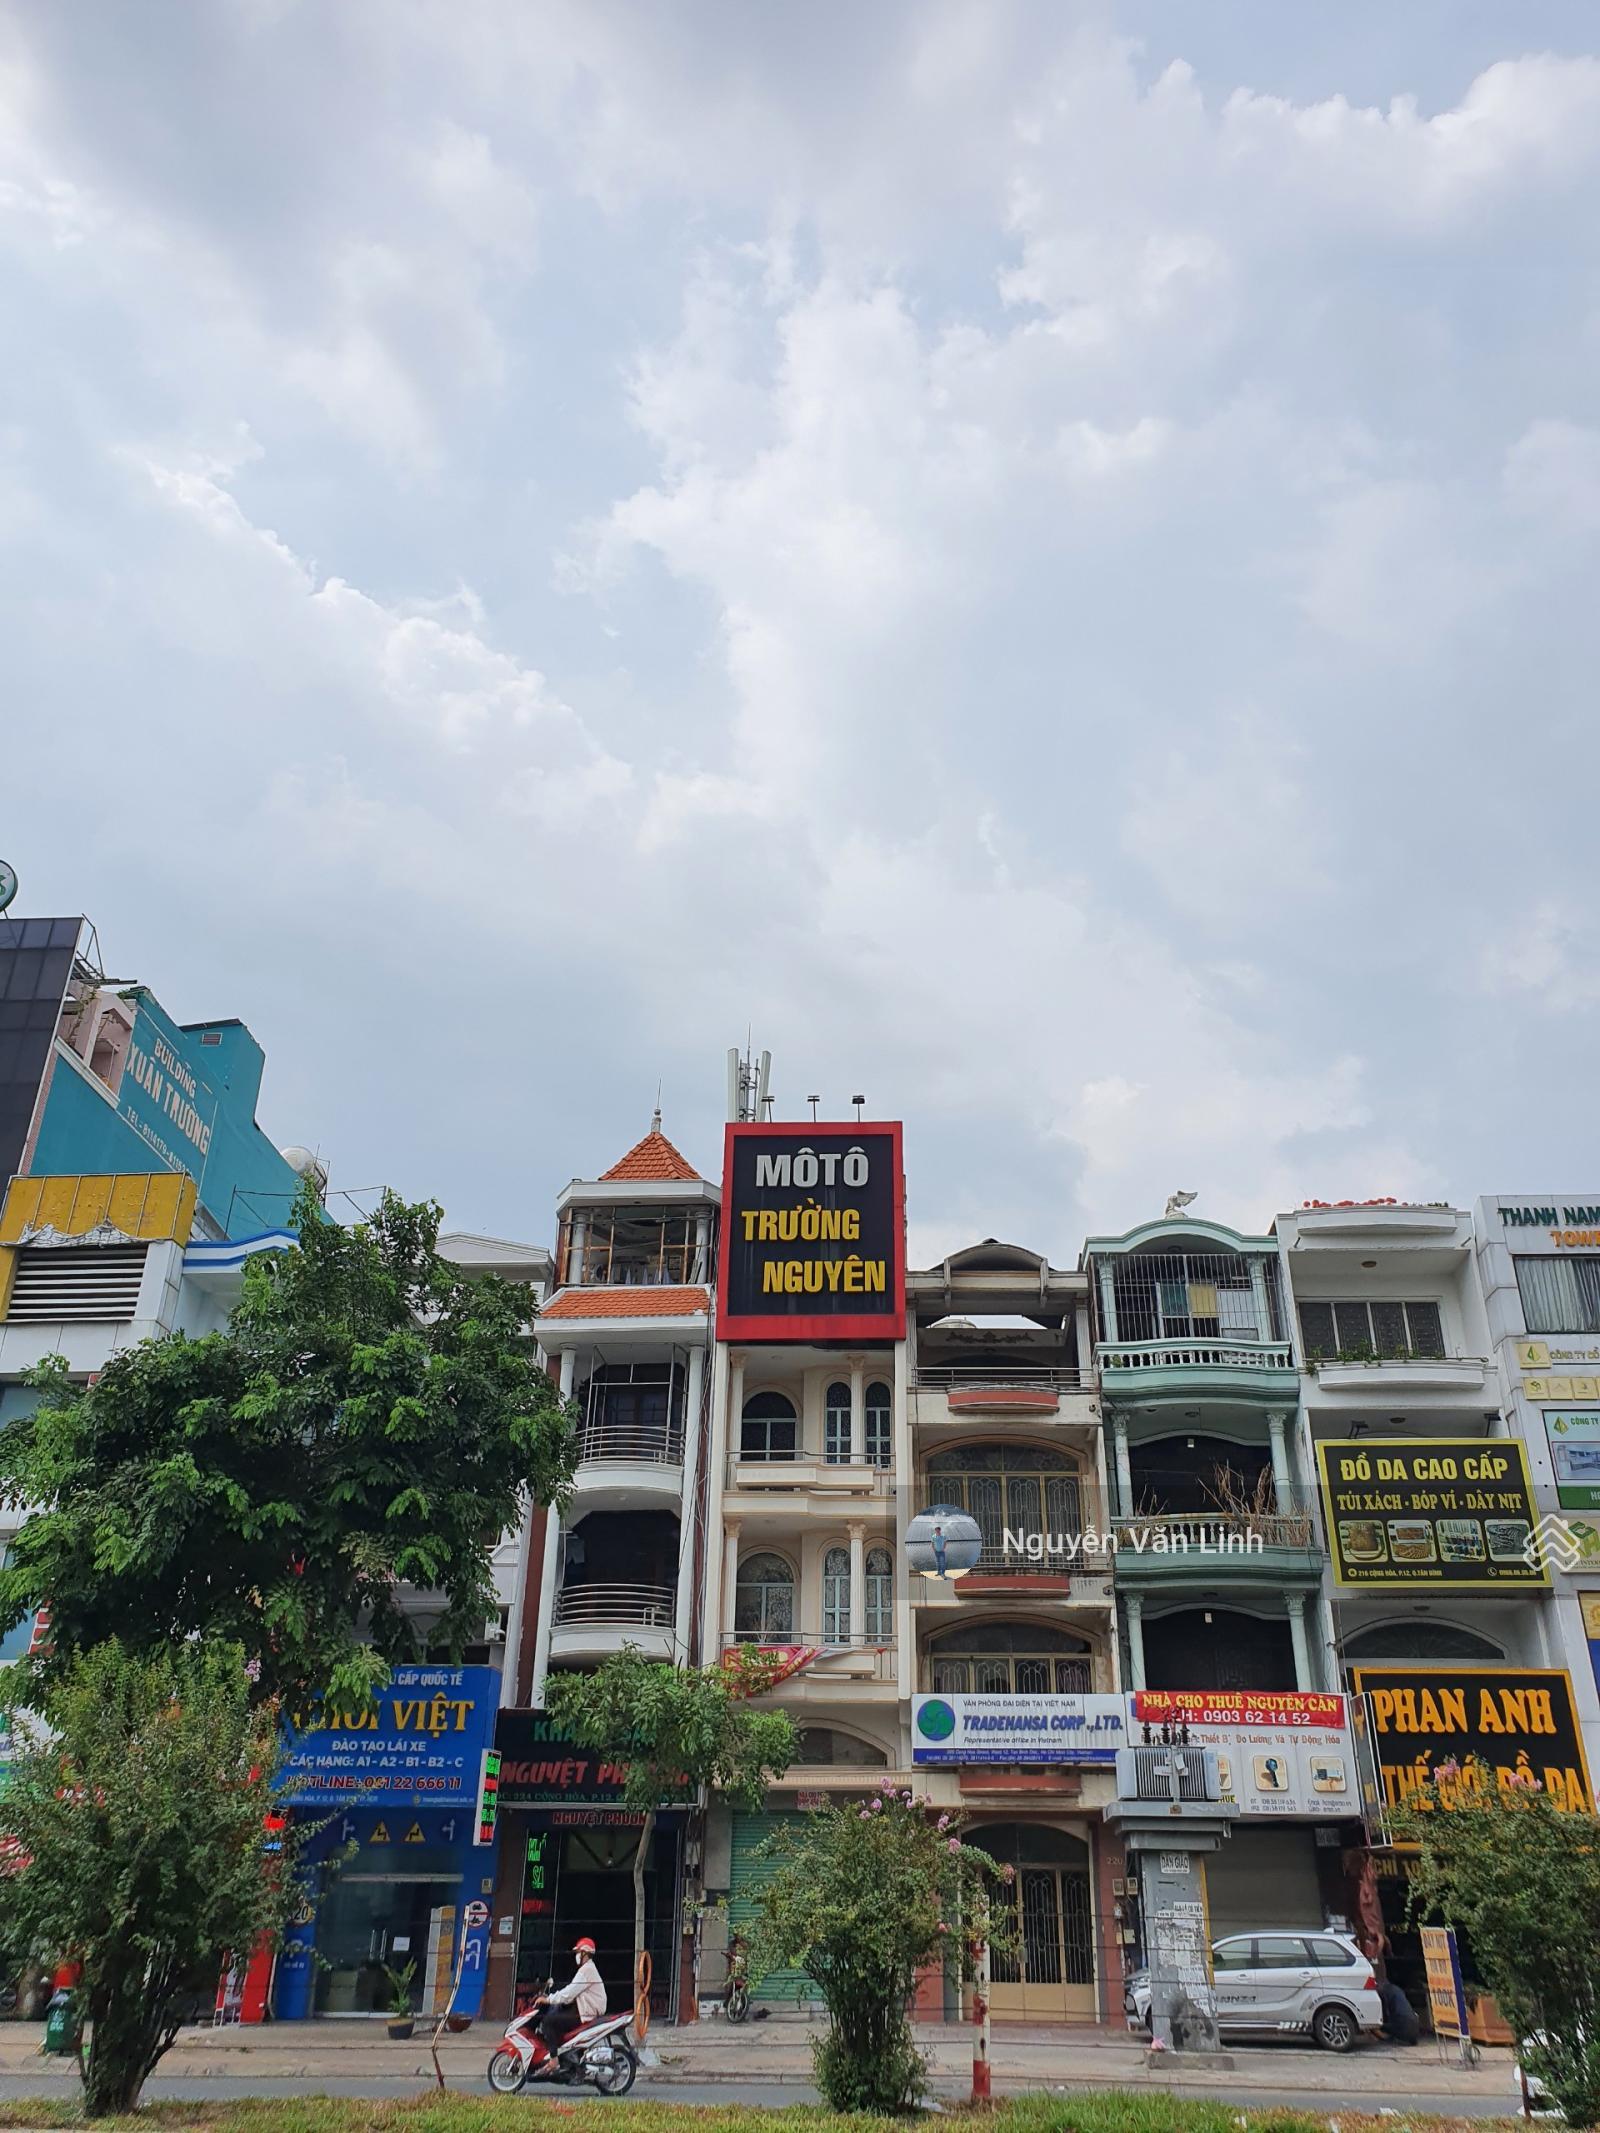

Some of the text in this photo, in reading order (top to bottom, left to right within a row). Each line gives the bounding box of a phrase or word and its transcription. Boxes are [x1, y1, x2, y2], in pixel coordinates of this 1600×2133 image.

[126, 1042, 164, 1103] XUÂN
[154, 1038, 197, 1098] BUILDING
[755, 1146, 869, 1188] MÔTÔ
[741, 1197, 861, 1241] TRƯỜNG
[1498, 1206, 1600, 1226] THANH NAM
[762, 1254, 886, 1293] NGUYÊN
[1339, 1450, 1509, 1481] ĐỒ DA CAO CẤP
[1337, 1488, 1523, 1514] TÚI XÁCH BÓP VÍ DÂY NỊT
[397, 1670, 420, 1686] CẤP
[420, 1670, 448, 1686] QUỐC
[449, 1669, 465, 1686] TẾ
[392, 1691, 475, 1738] VIỆT
[1142, 1691, 1338, 1713] NHÀ CHO THUÊ NGUYÊN CĂN
[1203, 1710, 1240, 1723] 0903
[1245, 1711, 1264, 1724] 62
[1270, 1711, 1287, 1724] 14
[1292, 1712, 1311, 1725] 52
[1371, 1687, 1557, 1734] PHAN ANH
[963, 1715, 1048, 1731] TRADEHANSA
[332, 1737, 427, 1754] ĐÀO TẠO LÁI XE
[356, 1755, 370, 1767] A1
[379, 1755, 397, 1767] A2
[405, 1756, 419, 1767] B1
[428, 1756, 445, 1768] B2
[454, 1756, 464, 1768] C
[500, 1757, 589, 1789] NGUYỆT
[393, 1775, 413, 1790] 22
[416, 1775, 446, 1790] 666
[1381, 1750, 1436, 1812] THẾ
[1543, 1767, 1588, 1814] DA
